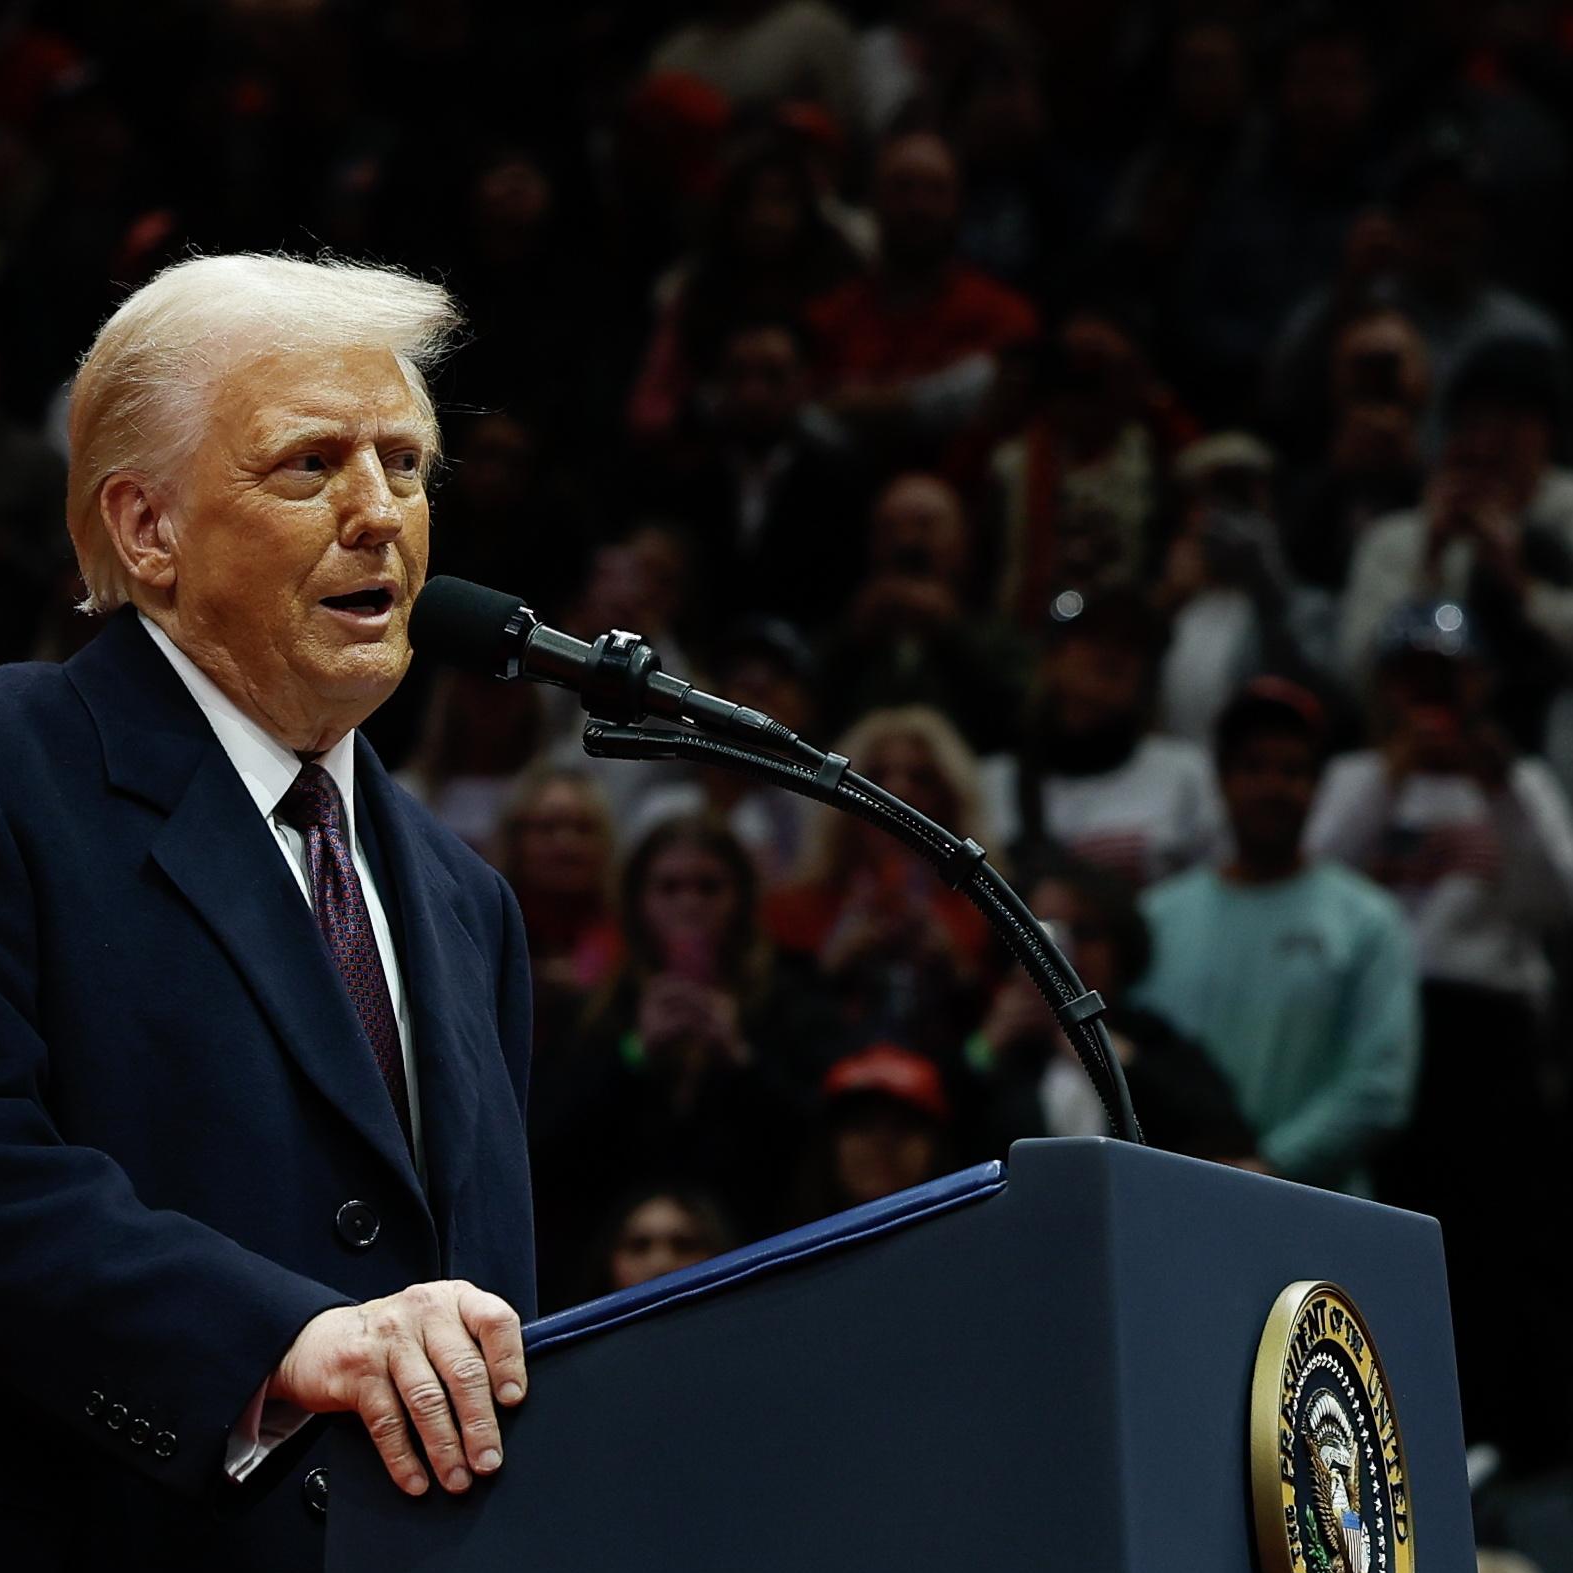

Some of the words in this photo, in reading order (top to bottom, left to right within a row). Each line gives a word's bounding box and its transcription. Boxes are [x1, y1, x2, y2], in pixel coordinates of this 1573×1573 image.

[1329, 1306, 1345, 1335] OF
[1345, 1315, 1364, 1365] THE
[1281, 1299, 1327, 1485] PRESIDENT
[1368, 1359, 1409, 1545] UNITED
[1284, 1504, 1303, 1566] THE
